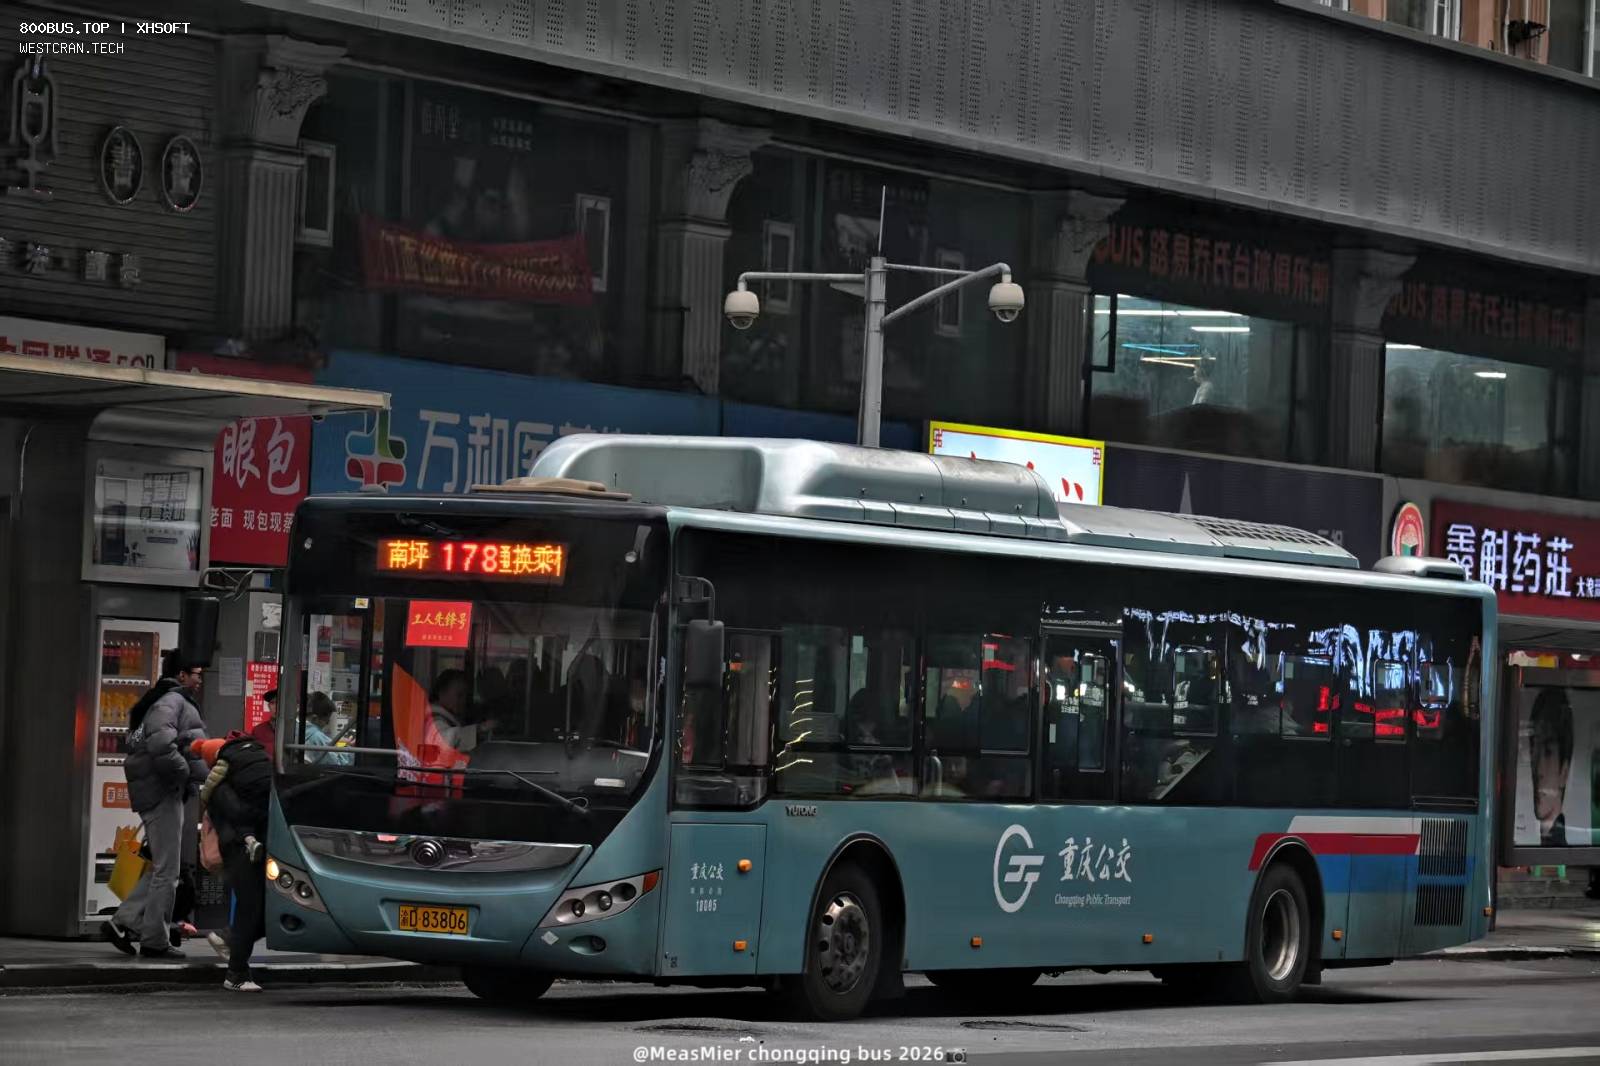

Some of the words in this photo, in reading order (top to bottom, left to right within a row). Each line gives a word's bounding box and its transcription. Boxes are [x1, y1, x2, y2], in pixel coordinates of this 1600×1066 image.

[388, 540, 429, 569] 南坪
[442, 543, 498, 573] 178
[1058, 837, 1132, 882] 重庆公交
